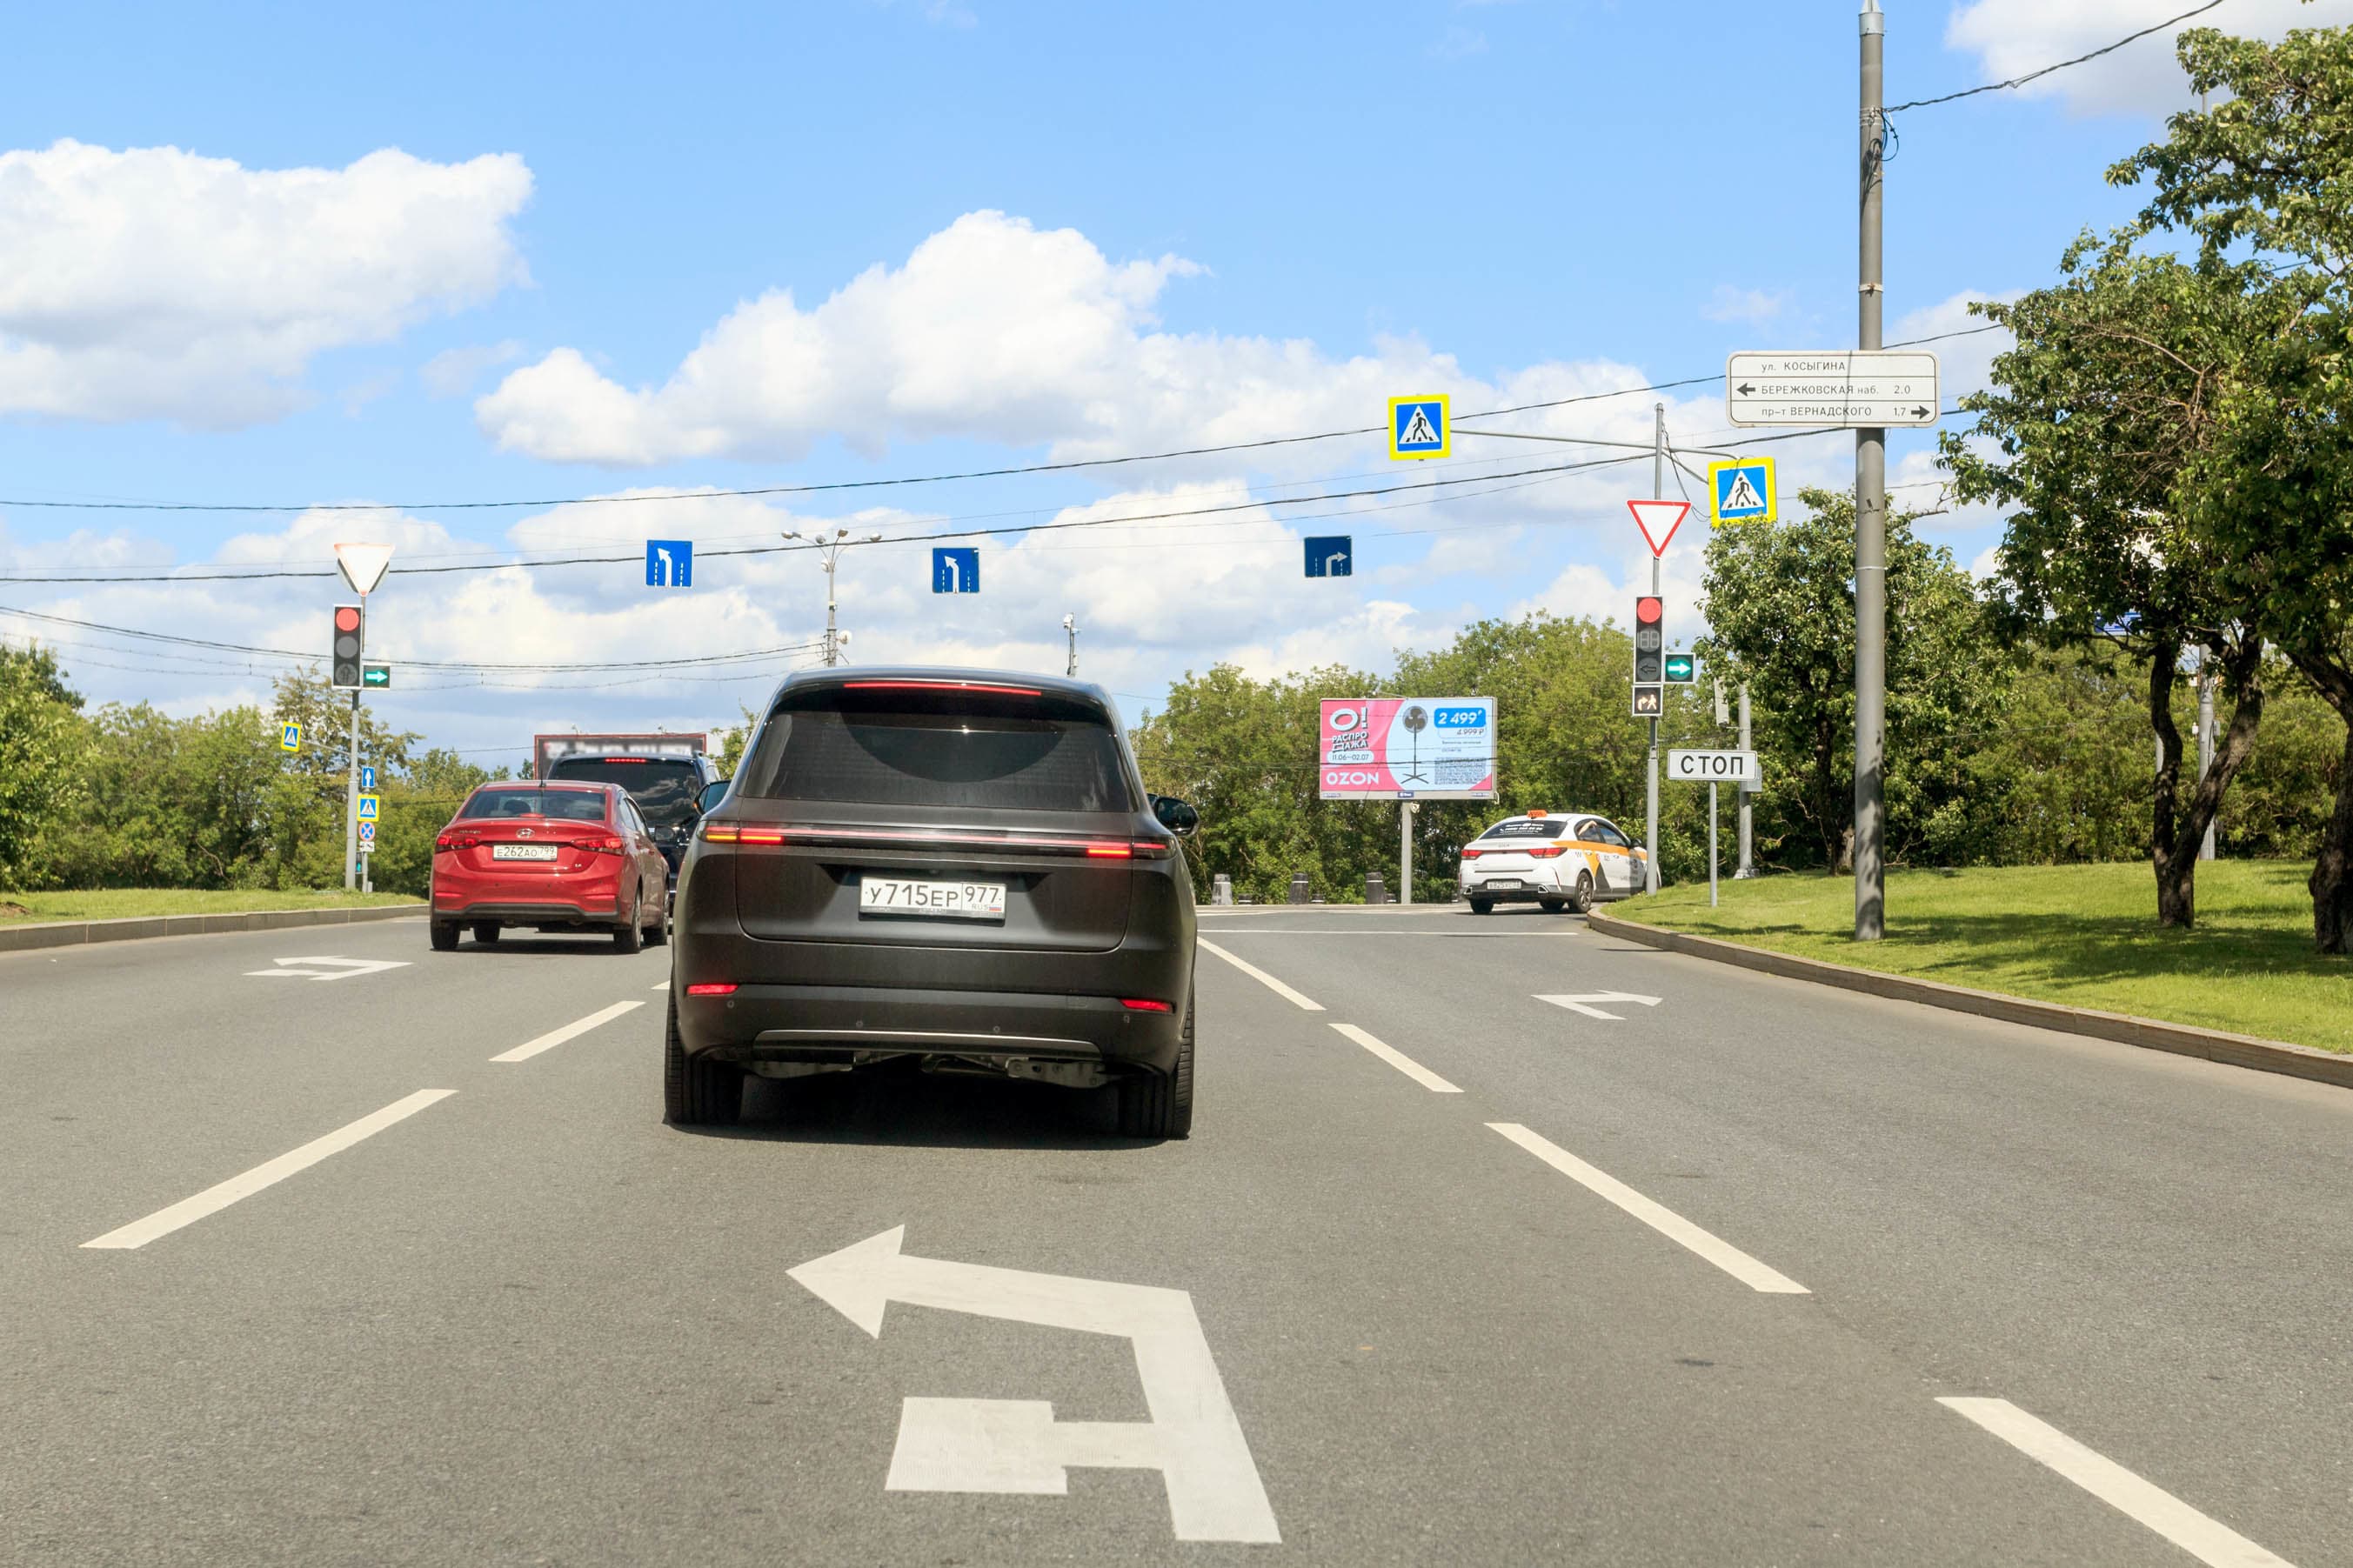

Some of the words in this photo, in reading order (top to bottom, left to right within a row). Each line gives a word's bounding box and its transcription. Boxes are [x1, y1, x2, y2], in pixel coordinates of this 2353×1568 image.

[1761, 362, 1776, 373] ул.
[1783, 361, 1846, 371] КОСЫГИНА
[1761, 384, 1854, 395] БЕРЕЖКОВСКАЯ
[1857, 384, 1879, 395] наб.
[1761, 407, 1787, 417] пр-т
[1789, 406, 1872, 417] ВЕРНАДСКОГО
[1681, 755, 1743, 775] СТОП
[1327, 772, 1379, 785] OZON
[870, 883, 959, 907] У715ЕР
[965, 886, 999, 904] 977
[972, 903, 989, 911] RUS
